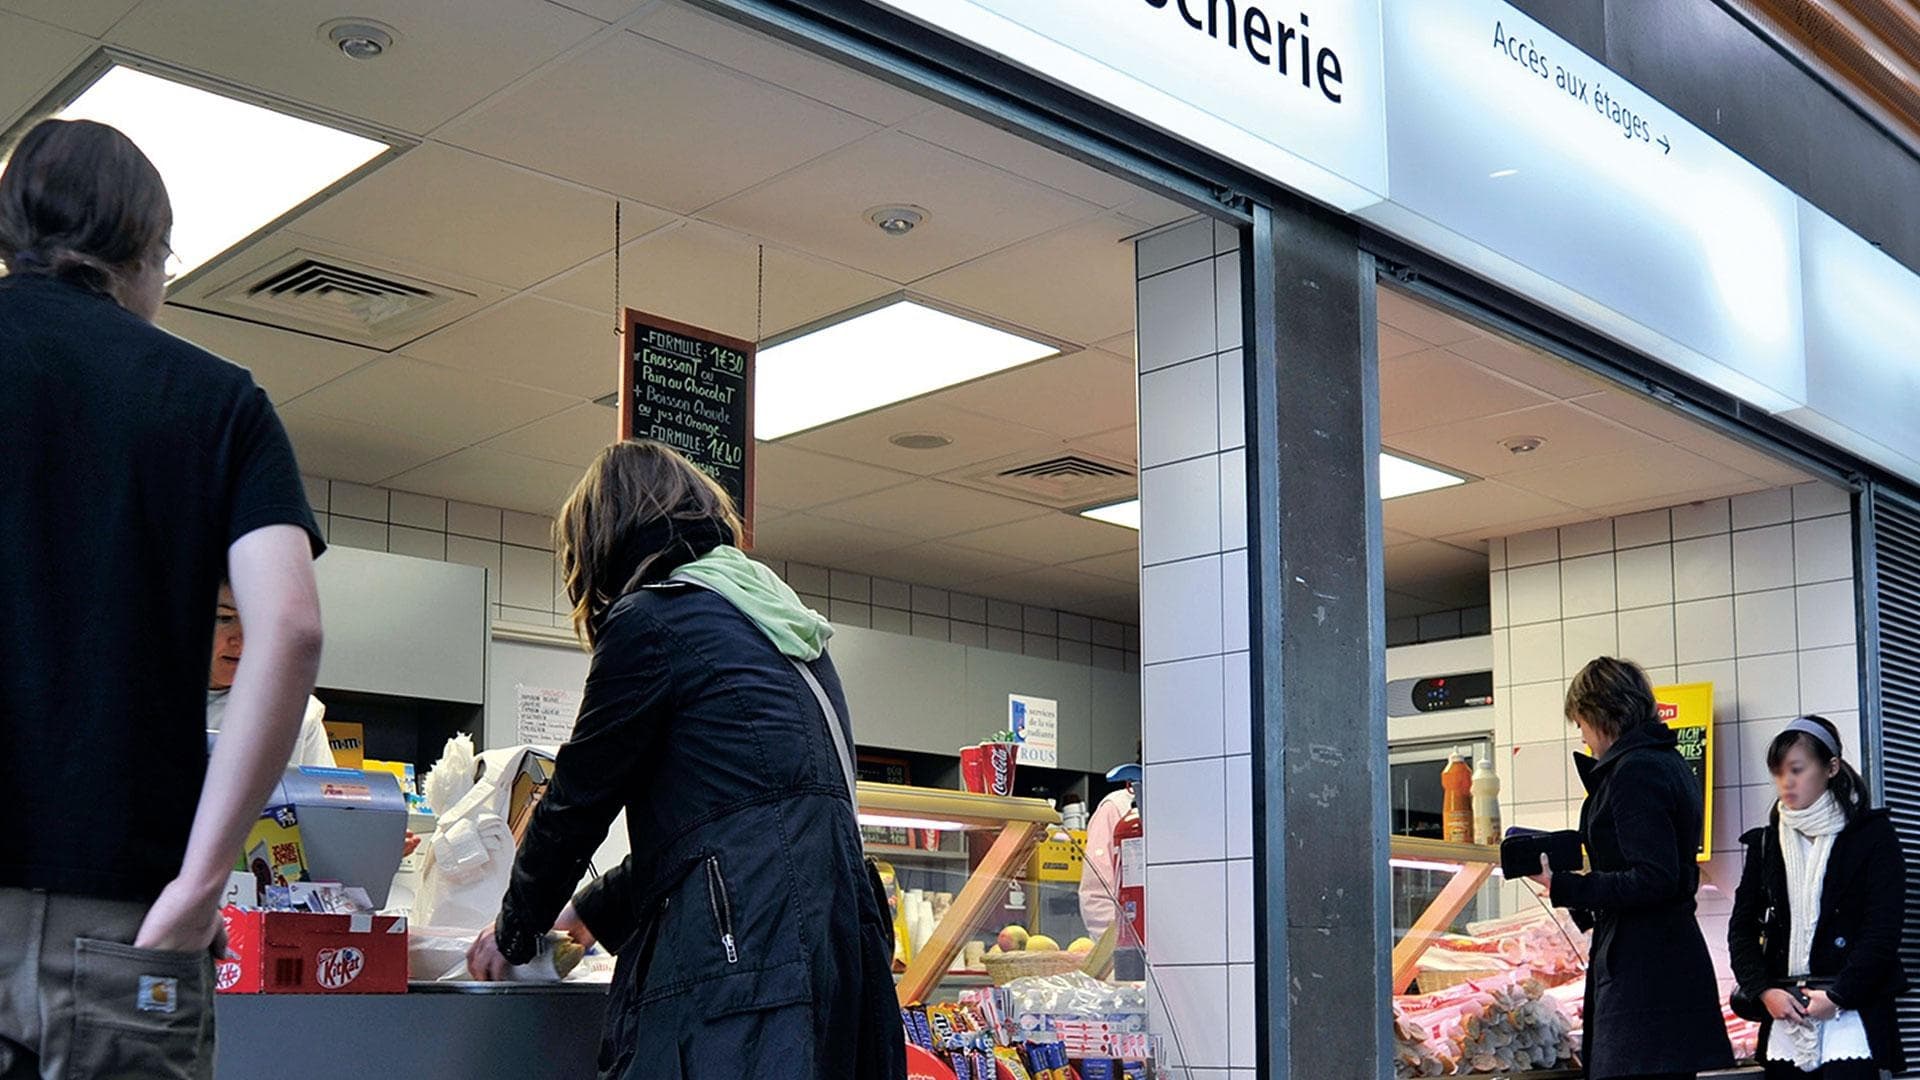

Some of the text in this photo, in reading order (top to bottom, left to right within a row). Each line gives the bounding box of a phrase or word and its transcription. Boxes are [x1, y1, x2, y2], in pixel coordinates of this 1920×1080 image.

[1493, 20, 1650, 143] Accès aux étages
[709, 346, 744, 373] 1€30
[643, 365, 666, 387] Pain
[646, 384, 690, 411] Boisson
[693, 399, 731, 425] Chaude
[654, 409, 673, 424] jus
[707, 438, 742, 464] 1€40
[1020, 747, 1055, 763] ROUS
